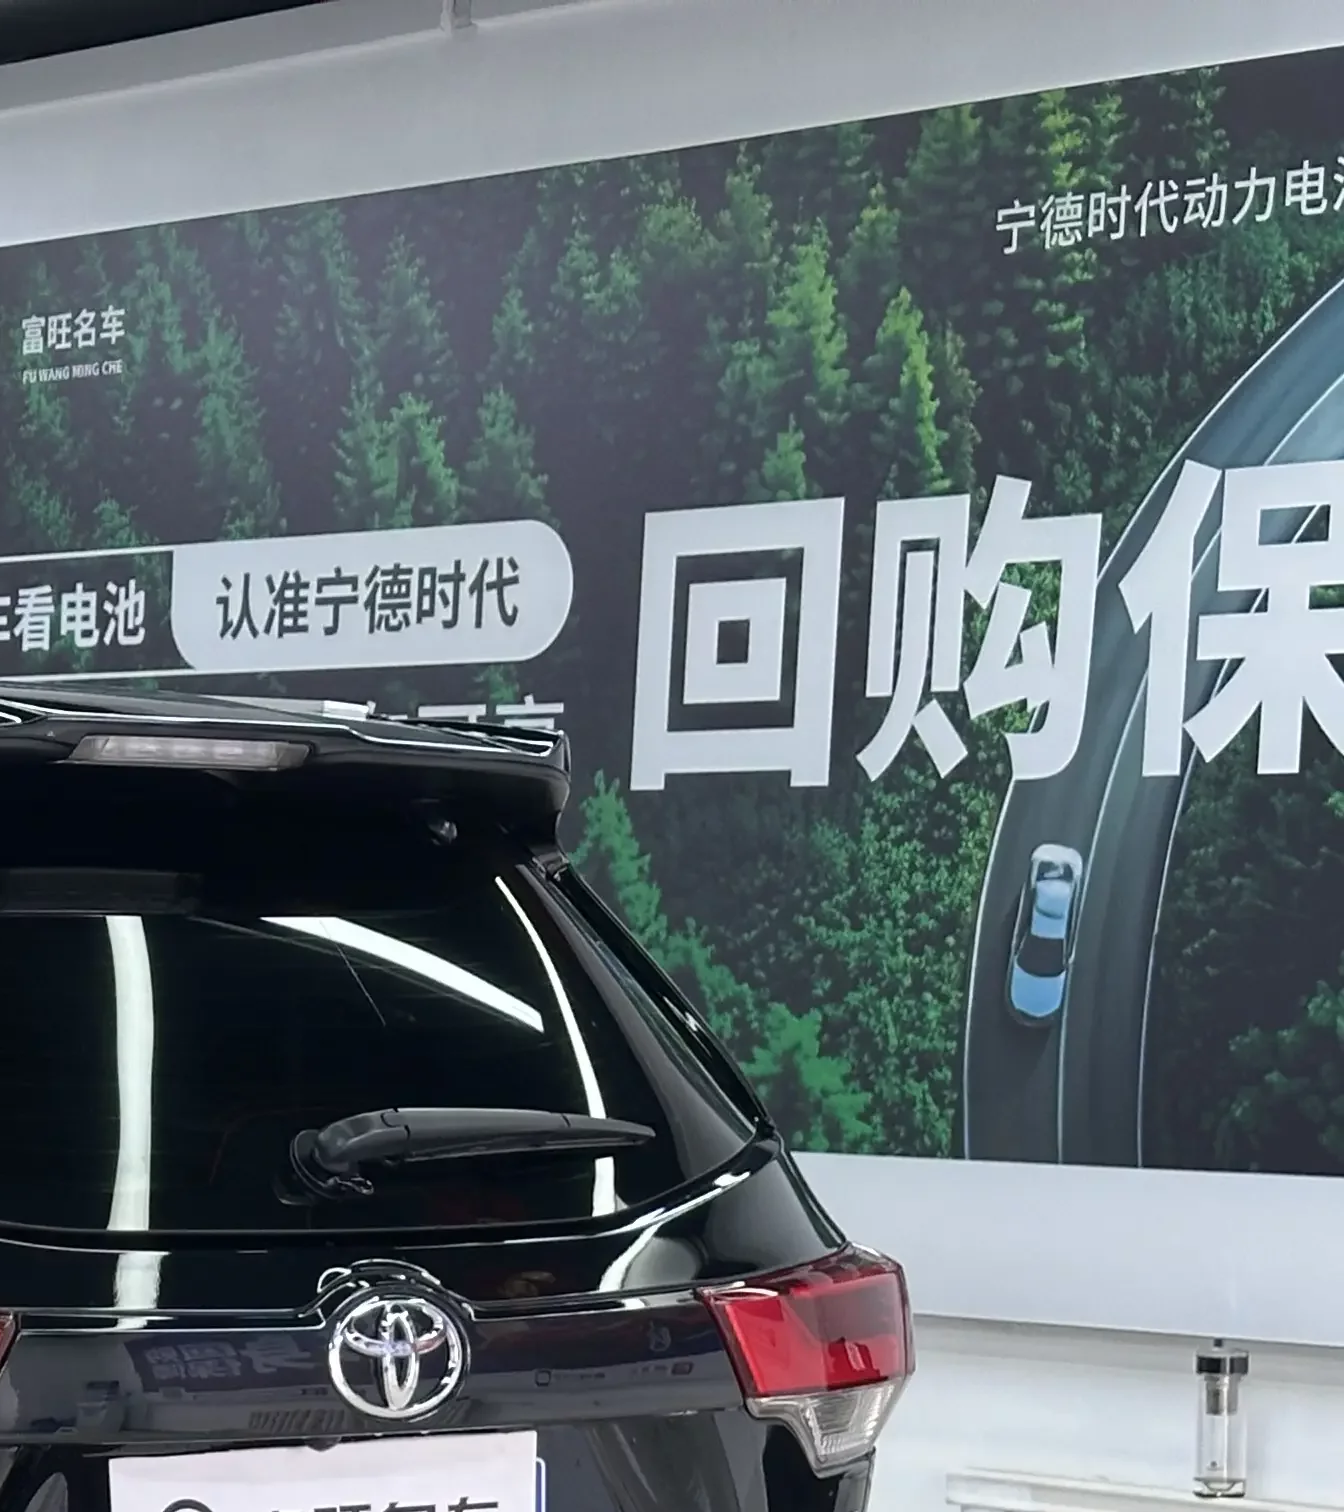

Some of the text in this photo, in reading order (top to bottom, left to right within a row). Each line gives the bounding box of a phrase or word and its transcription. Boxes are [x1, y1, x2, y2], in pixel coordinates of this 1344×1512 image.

[21, 305, 126, 356] 富旺名车
[22, 367, 36, 385] FU
[38, 364, 70, 383] WANG
[102, 358, 123, 375] CHE
[215, 556, 520, 642] 认准宁德时代
[630, 458, 1344, 791] 回购保
